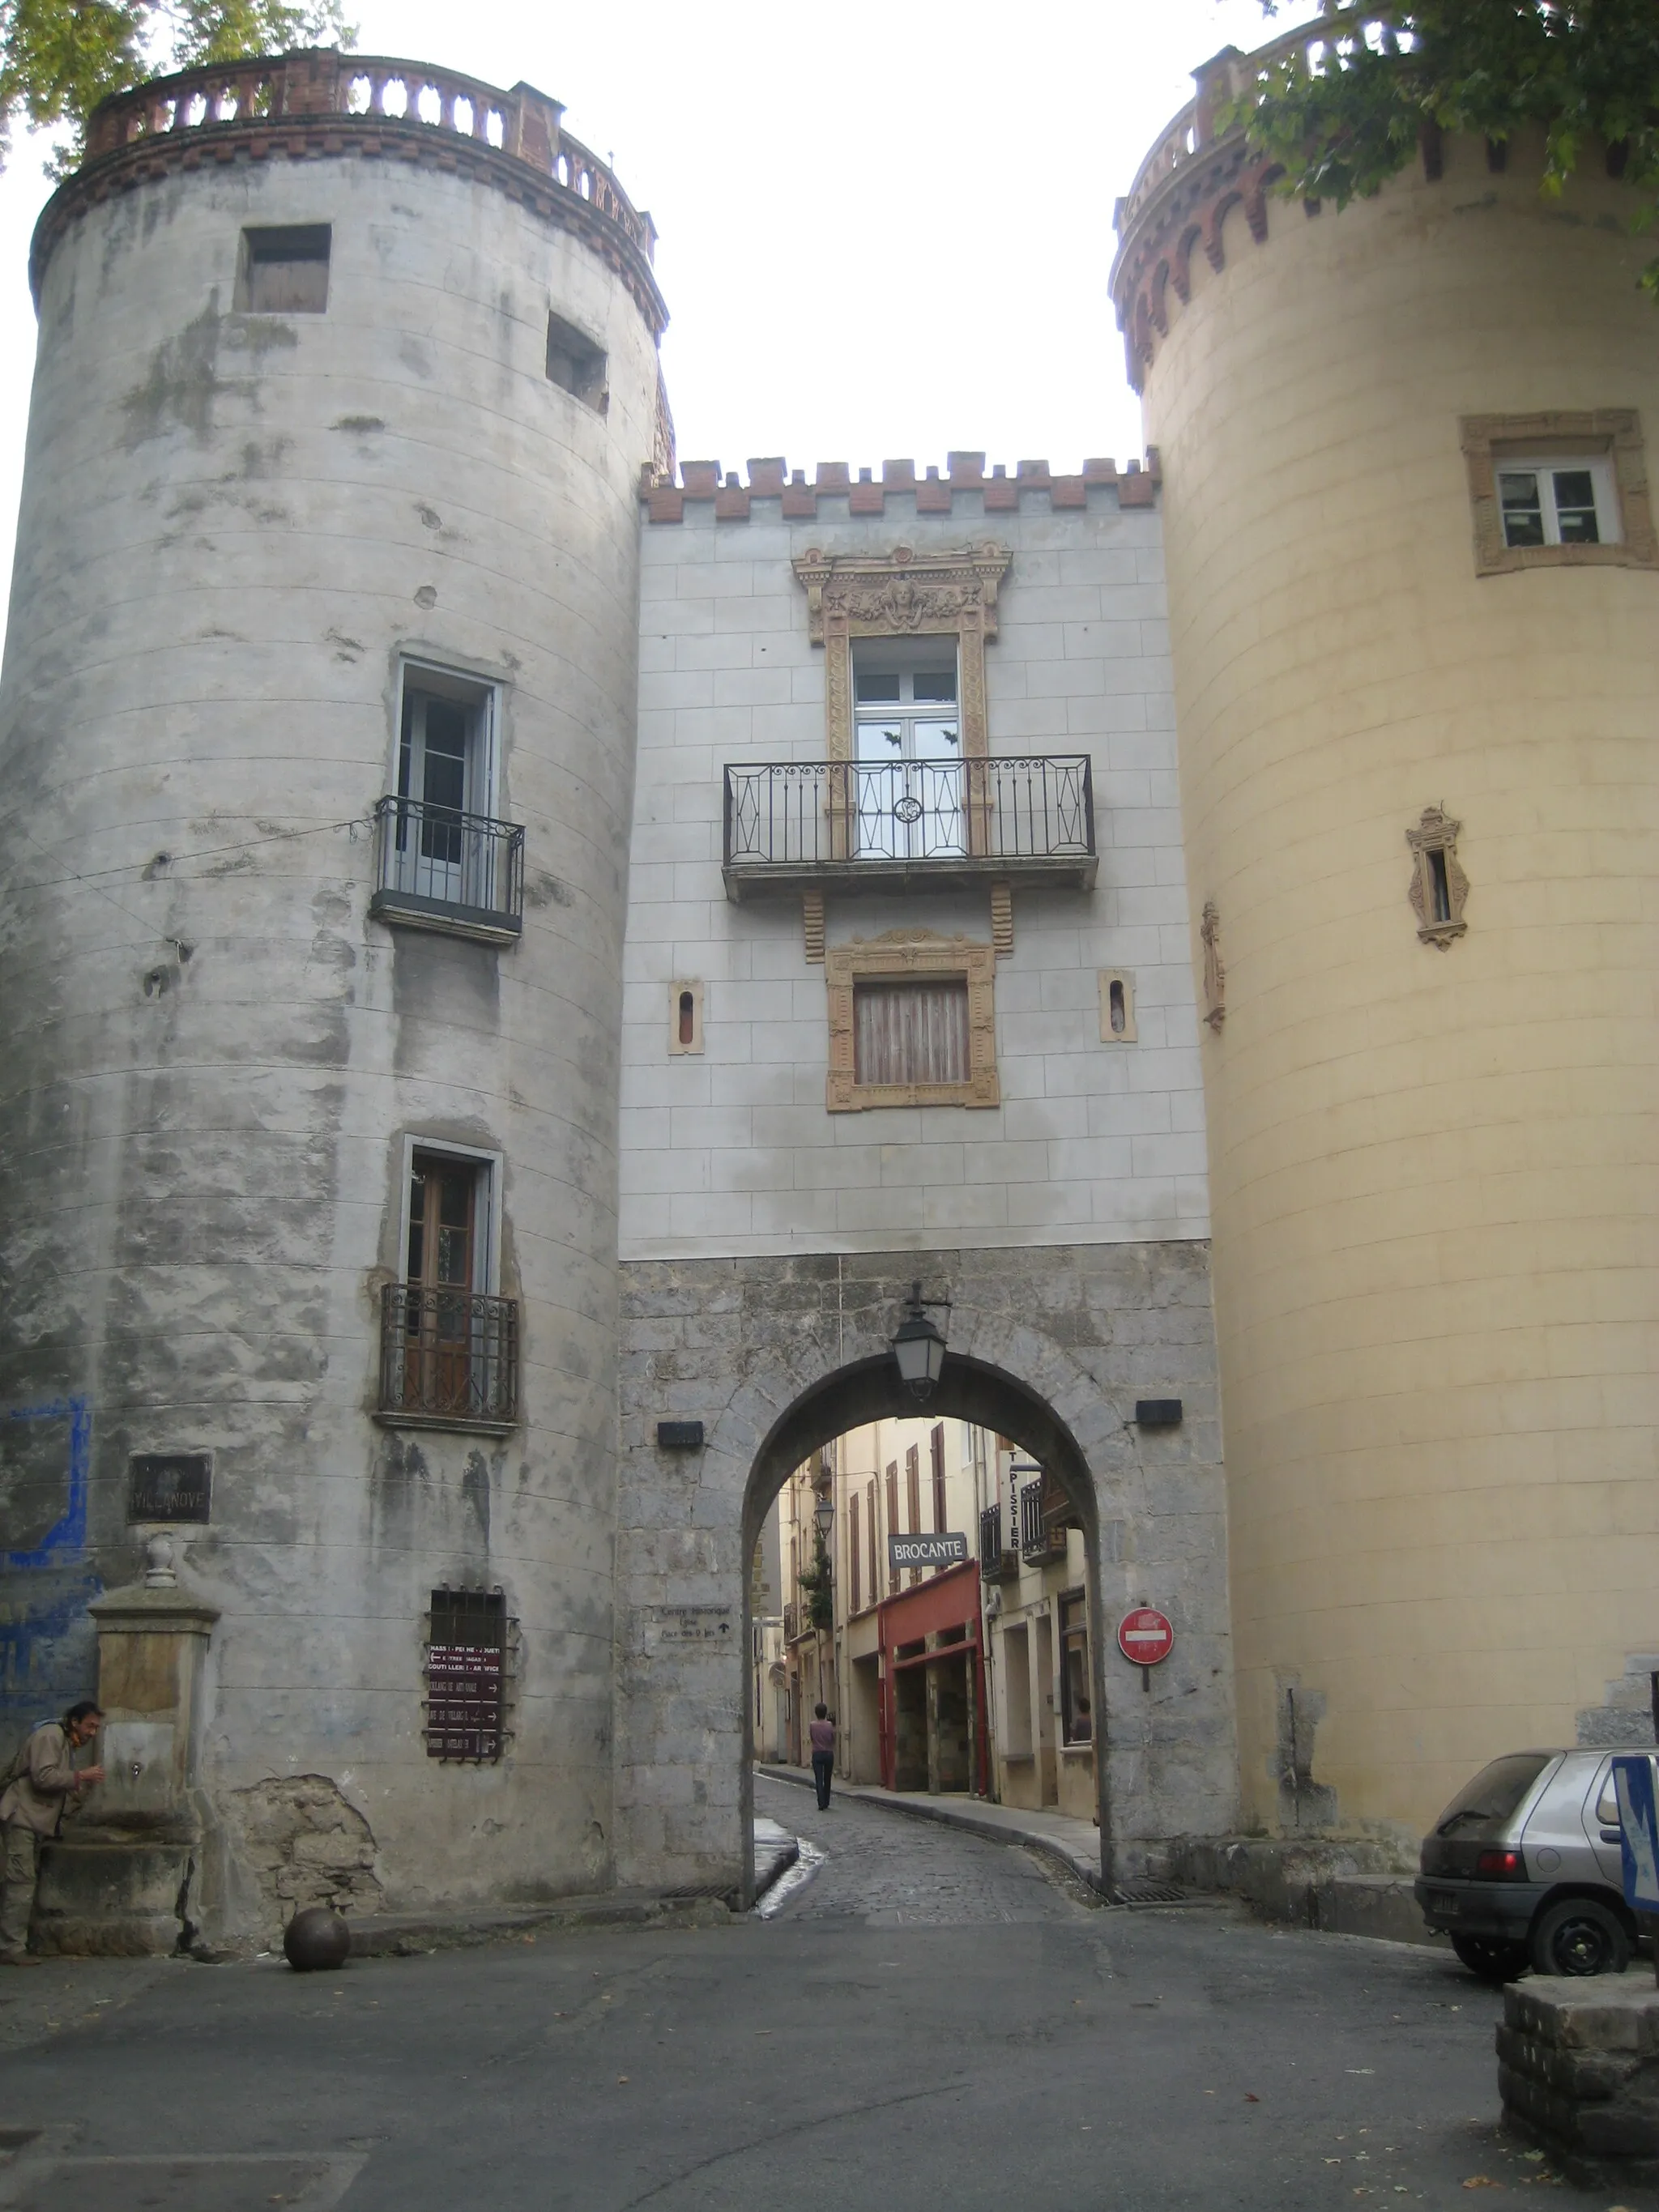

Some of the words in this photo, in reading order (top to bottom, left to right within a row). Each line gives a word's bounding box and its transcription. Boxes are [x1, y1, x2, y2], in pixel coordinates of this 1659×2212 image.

[1009, 1452, 1018, 1548] TPISSIER
[894, 1541, 962, 1560] BROCANTE
[662, 1607, 687, 1616] Centre
